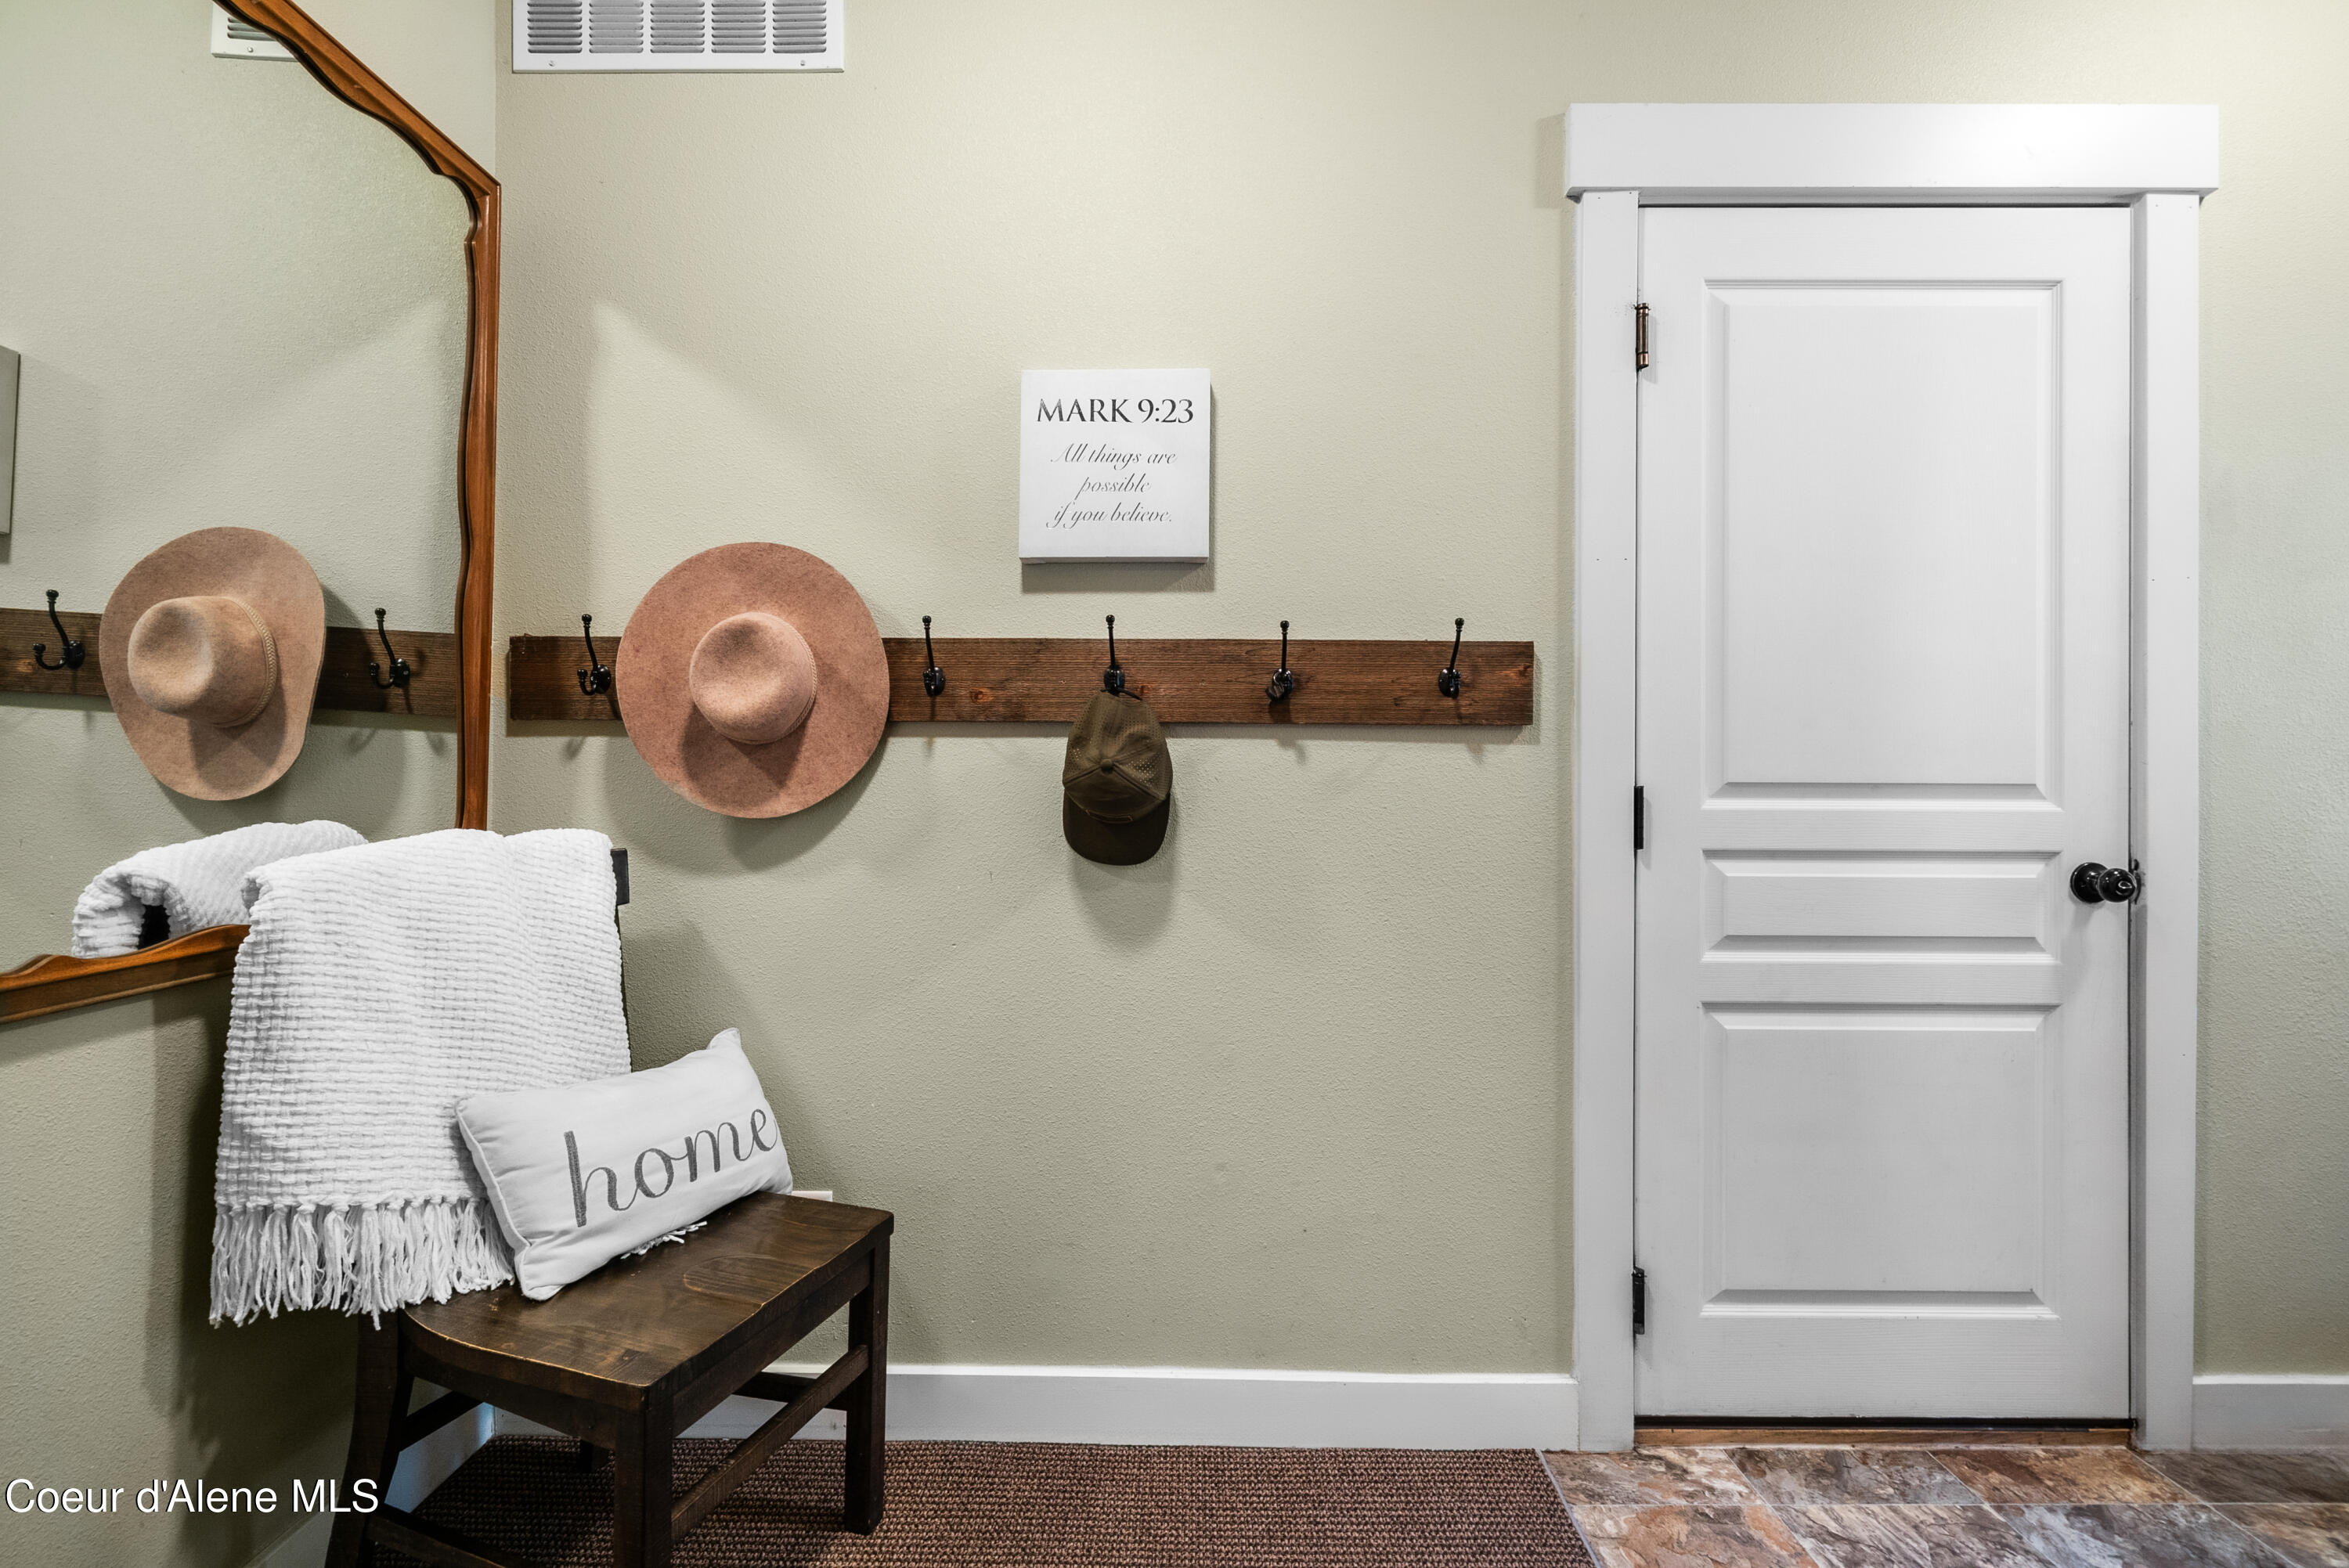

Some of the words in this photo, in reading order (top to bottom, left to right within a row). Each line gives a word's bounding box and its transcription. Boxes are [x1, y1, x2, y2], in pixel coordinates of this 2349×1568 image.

[1037, 398, 1134, 424] MARK
[1138, 398, 1194, 424] 9:23
[1050, 443, 1088, 463] All
[1088, 443, 1142, 470] things
[1147, 452, 1178, 464] are
[1073, 473, 1152, 501] possible
[1045, 500, 1076, 529] if
[1063, 509, 1110, 529] you
[1110, 501, 1172, 522] believe.
[563, 1108, 778, 1227] home
